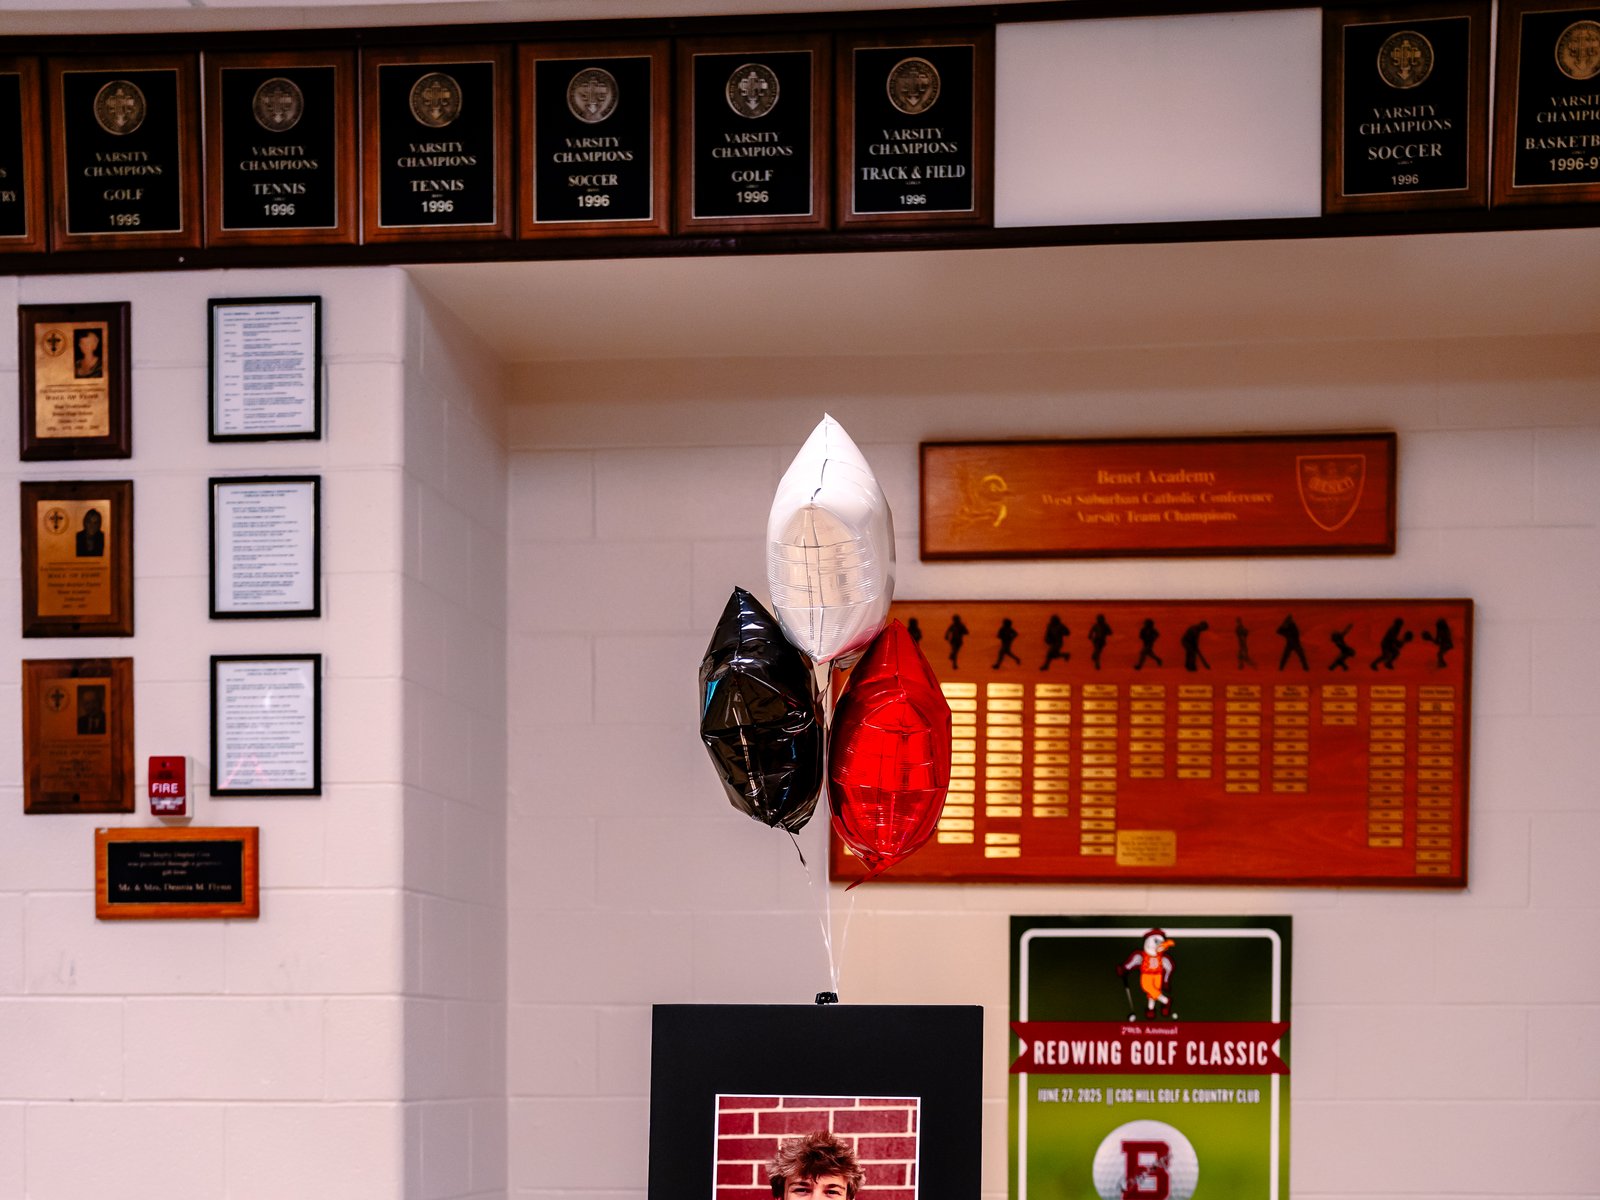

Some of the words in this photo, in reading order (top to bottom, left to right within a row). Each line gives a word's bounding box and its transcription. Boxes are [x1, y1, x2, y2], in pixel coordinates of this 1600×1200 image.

[1550, 94, 1600, 107] VARSIT
[1373, 104, 1437, 119] VARSITY
[1358, 119, 1452, 136] CHAMPIONS
[724, 132, 780, 144] VARSITY
[882, 128, 944, 141] VARSITY
[409, 142, 465, 154] VARSITY
[565, 137, 621, 149] VARSITY
[1525, 134, 1600, 150] BASKETB
[251, 145, 306, 157] VARSITY
[711, 145, 793, 159] CHAMPIONS
[869, 142, 958, 156] CHAMPIONS
[1367, 143, 1442, 161] SOCCER
[95, 151, 149, 163] VARSITY
[397, 155, 477, 169] CHAMPIONS
[552, 150, 634, 164] CHAMPIONS
[1549, 156, 1600, 171] 1996-9
[83, 164, 163, 177] CHAMPIONS
[239, 158, 319, 172] CHAMPIONS
[731, 169, 774, 182] GOLF
[861, 166, 908, 180] TRACK
[911, 166, 921, 179] &
[926, 165, 965, 179] FIELD
[410, 179, 465, 192] TENNIS
[567, 173, 618, 187] SOCCER
[1391, 174, 1419, 186] 1996
[103, 188, 145, 201] GOLF
[252, 182, 307, 196] TENNIS
[577, 194, 610, 207] 1996
[736, 191, 769, 203] 1996
[900, 194, 927, 205] 1996
[263, 203, 296, 216] 1996
[421, 200, 454, 213] 1996
[109, 213, 141, 226] 1995
[1097, 470, 1141, 484] Benet
[1148, 468, 1216, 486] Academy
[152, 783, 179, 794] FIRE
[1033, 1040, 1122, 1066] REDWING
[1130, 1040, 1178, 1066] GOLF
[1186, 1040, 1269, 1066] CLASSIC
[1037, 1088, 1059, 1103] JUNE
[1078, 1088, 1103, 1103] 2025
[1115, 1088, 1133, 1104] COG
[1135, 1088, 1156, 1103] HILL
[1158, 1088, 1180, 1104] GOLF
[1182, 1088, 1191, 1103] &
[1192, 1088, 1235, 1104] COUNTRY
[1236, 1088, 1261, 1104] CLUB
